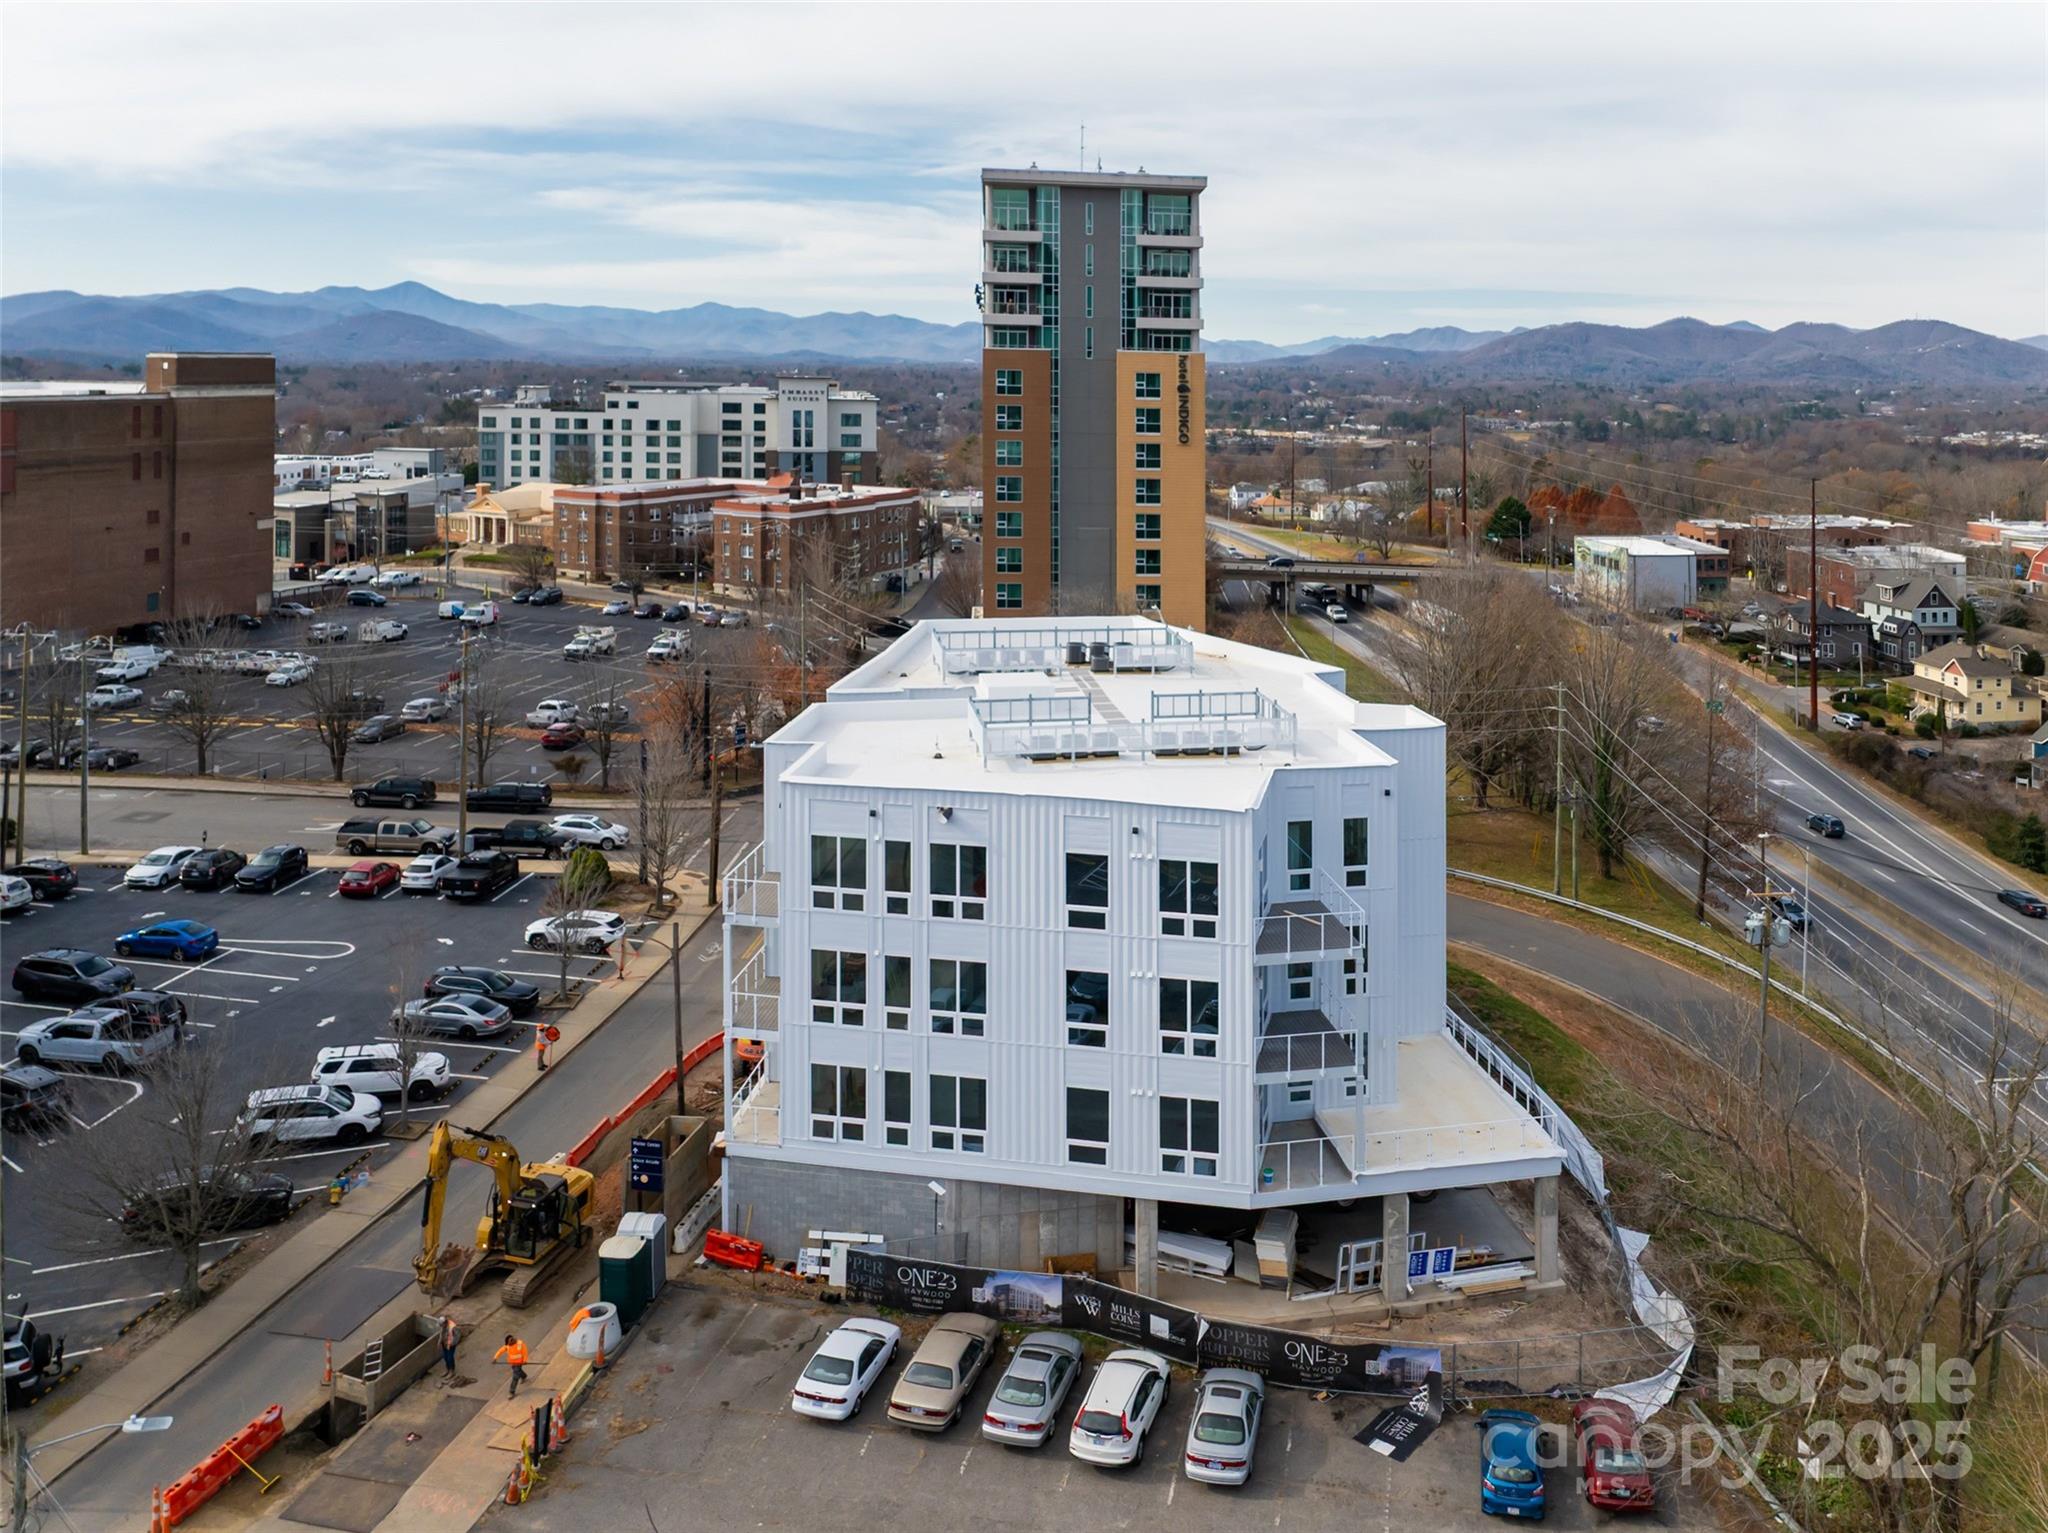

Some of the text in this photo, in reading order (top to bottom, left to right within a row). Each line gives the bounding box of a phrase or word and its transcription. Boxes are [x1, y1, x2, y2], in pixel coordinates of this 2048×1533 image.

[1178, 355, 1189, 444] hotel INDIGO
[897, 1266, 957, 1291] ONE23
[904, 1287, 951, 1299] HAYWOOD
[1200, 1341, 1271, 1361] BUILDERS
[1291, 1362, 1342, 1374] HAYWOOD
